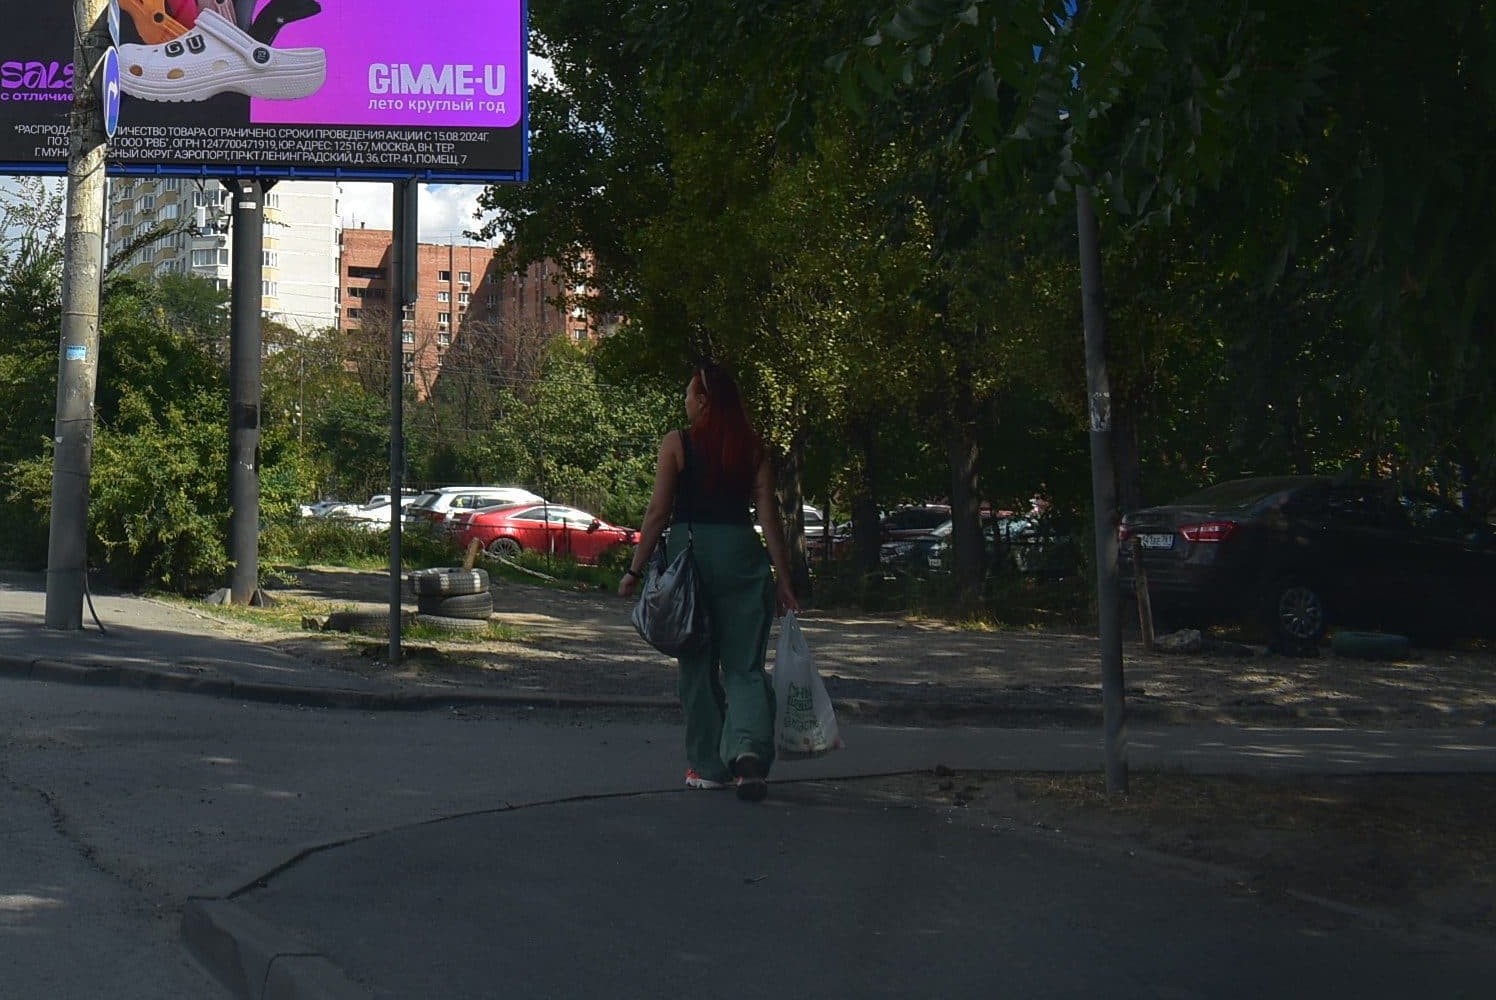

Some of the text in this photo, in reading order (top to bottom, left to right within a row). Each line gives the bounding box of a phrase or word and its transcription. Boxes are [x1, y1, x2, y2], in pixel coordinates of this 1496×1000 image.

[11, 92, 74, 101] отличие
[368, 98, 506, 114] лето круглый год
[168, 126, 206, 137] ТОВАРА
[278, 128, 314, 138] СРОКИ
[315, 129, 385, 141] ПРОВЕДЕНИЯ
[385, 131, 423, 141] АКЦИИ
[424, 131, 432, 140] С
[47, 136, 62, 146] ПО
[120, 138, 143, 147] ООО
[173, 138, 200, 148] ОГРН
[140, 149, 173, 159] ОКРУГ
[461, 154, 467, 164] 7
